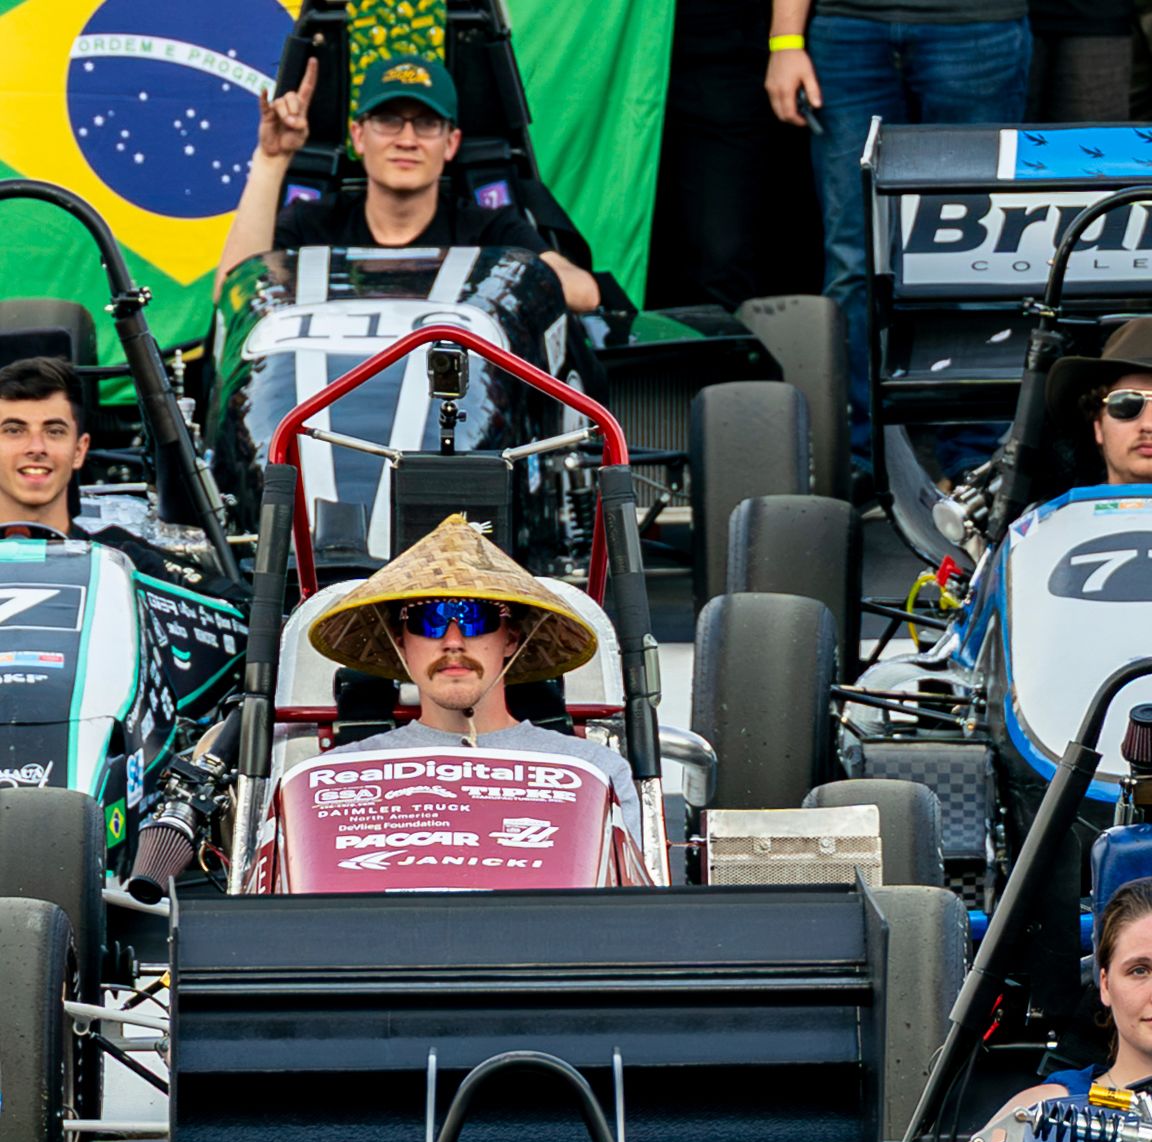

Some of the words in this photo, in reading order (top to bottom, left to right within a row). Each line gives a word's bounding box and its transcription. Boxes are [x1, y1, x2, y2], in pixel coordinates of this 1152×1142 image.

[78, 36, 153, 53] ORDEM
[164, 45, 176, 57] E
[0, 673, 48, 684] KF
[310, 761, 524, 787] RealDigital
[461, 785, 577, 803] TIPKE
[318, 806, 402, 819] DAIMLER
[411, 803, 471, 813] TRUCK
[349, 815, 385, 823] North
[389, 811, 440, 821] America
[384, 818, 450, 830] Foundation
[335, 831, 480, 850] PACCAR
[397, 856, 543, 868] JANICKI
